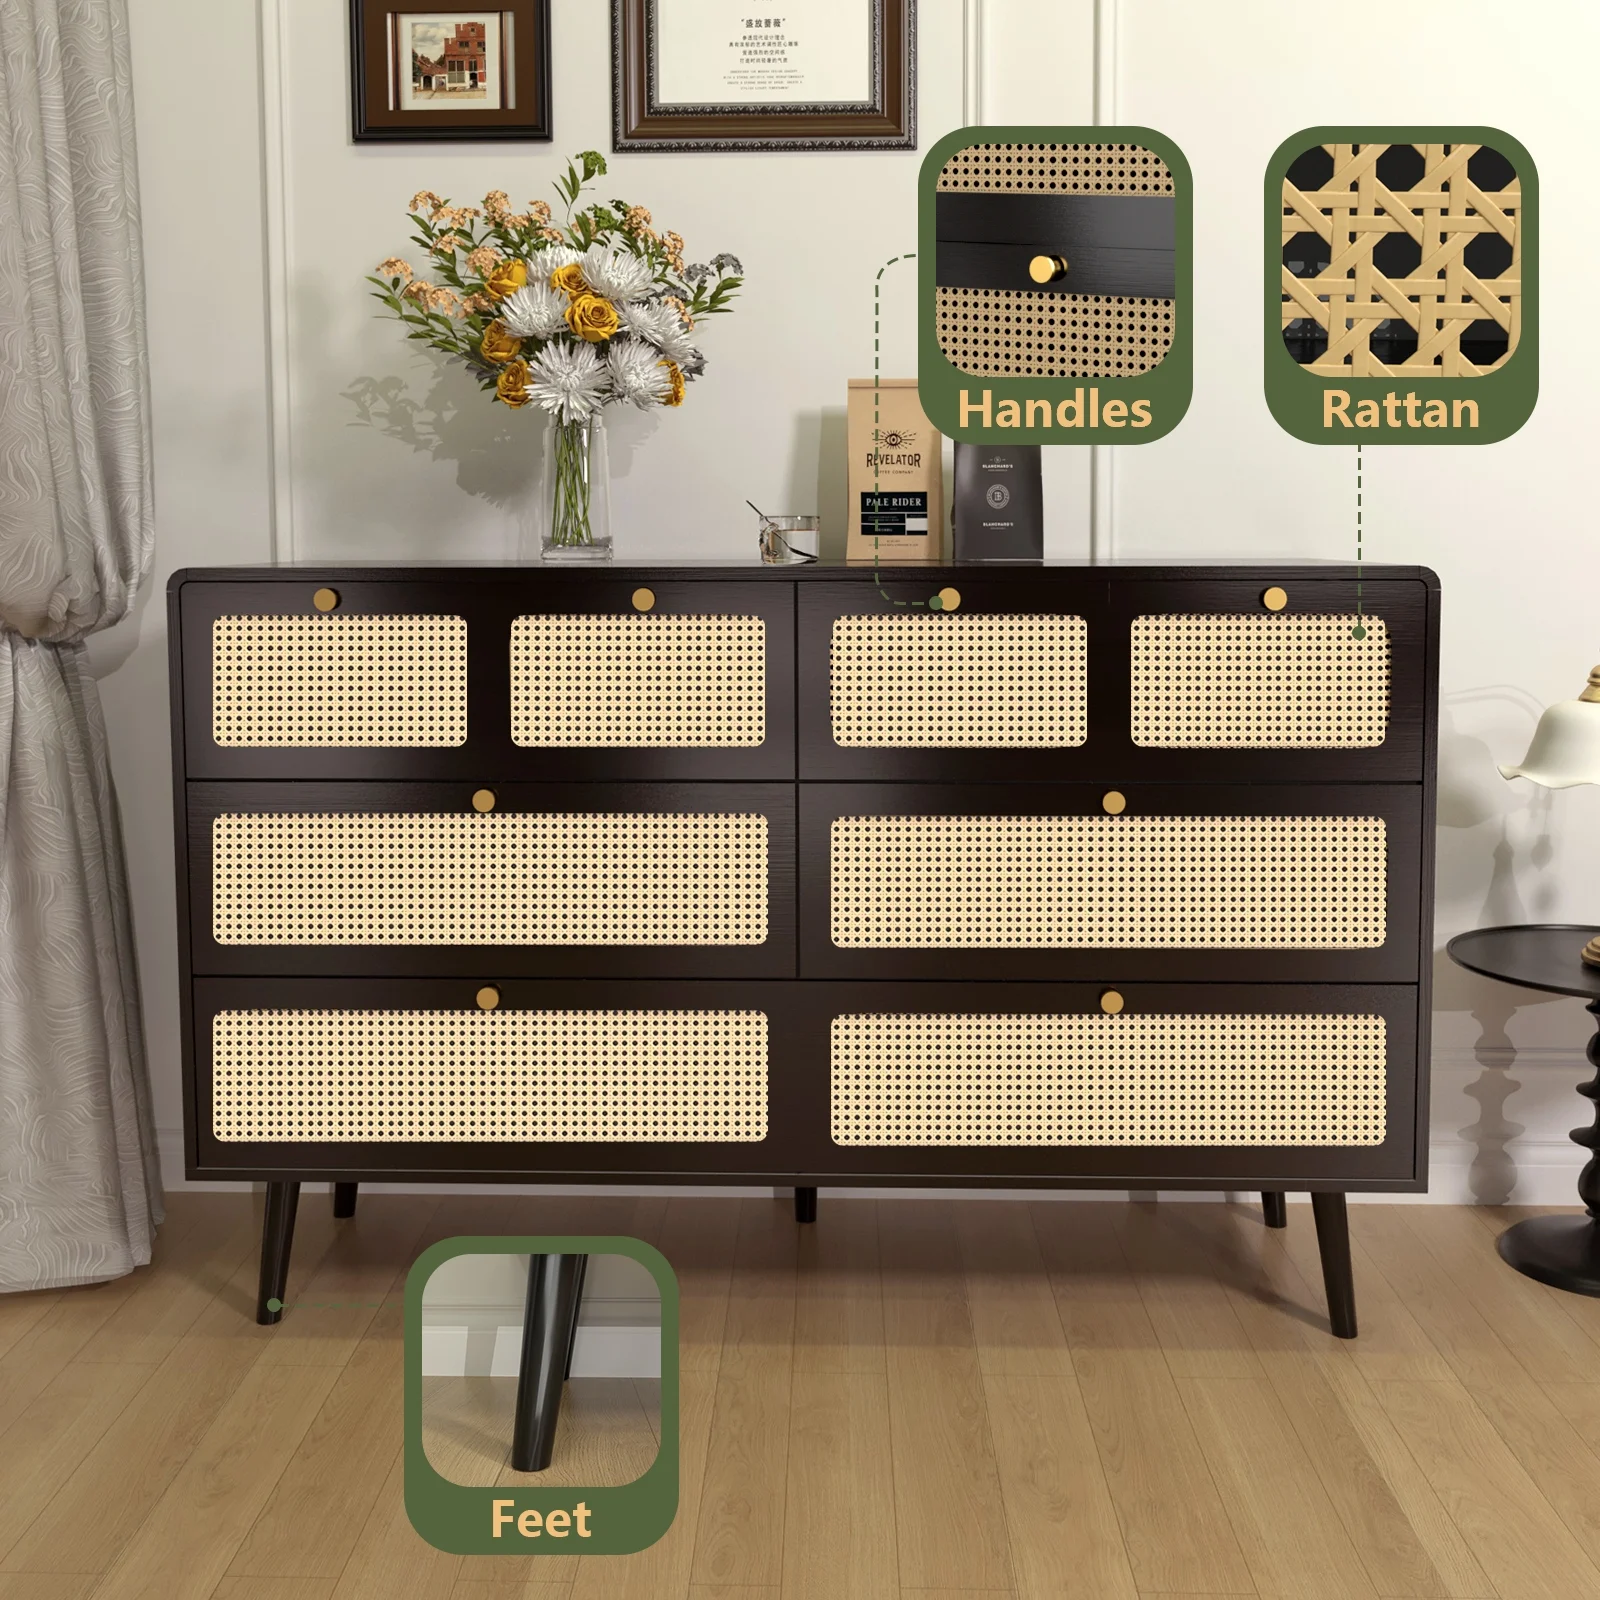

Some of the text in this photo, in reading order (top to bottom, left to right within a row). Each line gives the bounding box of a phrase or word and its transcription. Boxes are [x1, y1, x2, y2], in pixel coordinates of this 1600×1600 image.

[866, 453, 921, 468] REVELATOR
[866, 497, 922, 507] PALE RIDER
